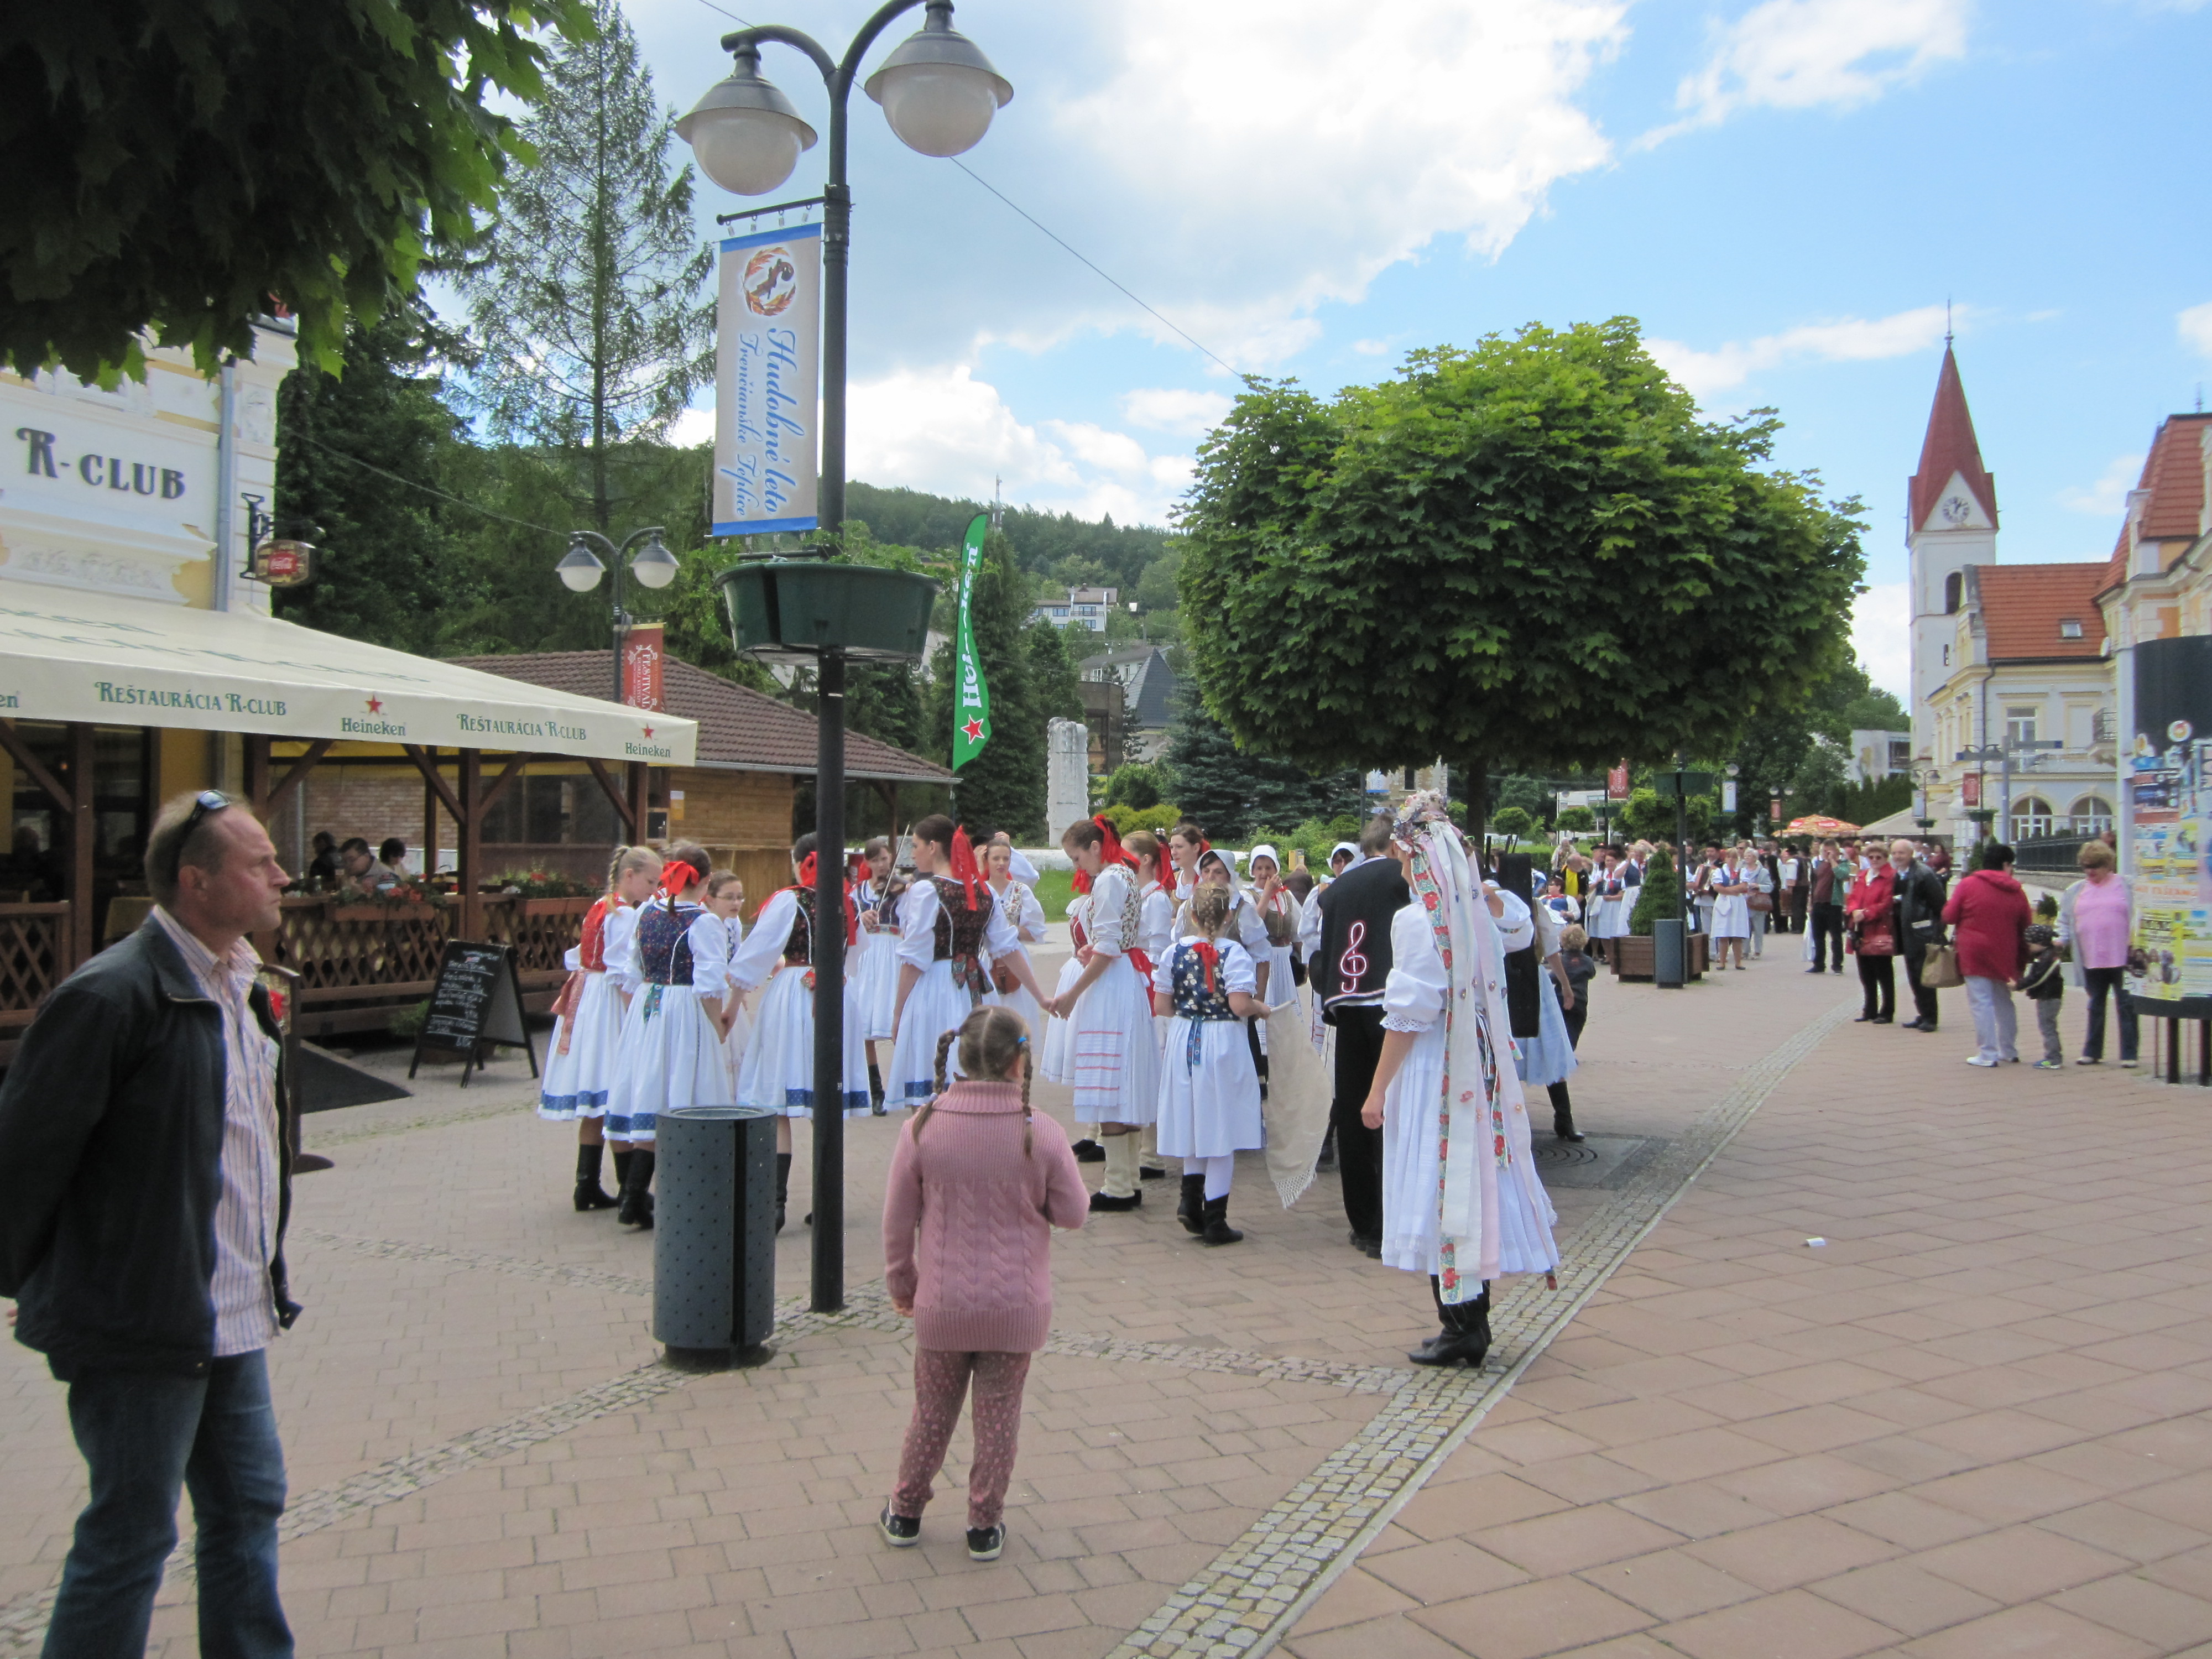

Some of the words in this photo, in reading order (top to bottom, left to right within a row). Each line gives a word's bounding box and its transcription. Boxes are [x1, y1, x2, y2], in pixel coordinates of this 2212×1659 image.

[737, 333, 763, 444] Trenčianske
[765, 328, 805, 463] Hudobné
[720, 453, 760, 517] Teplice
[764, 468, 796, 515] leto
[642, 654, 651, 707] FESTIVAL
[225, 693, 286, 716] R-CLUB
[341, 717, 406, 737] Heineken
[544, 721, 586, 740] R-CLUB
[625, 742, 671, 758] Heineken
